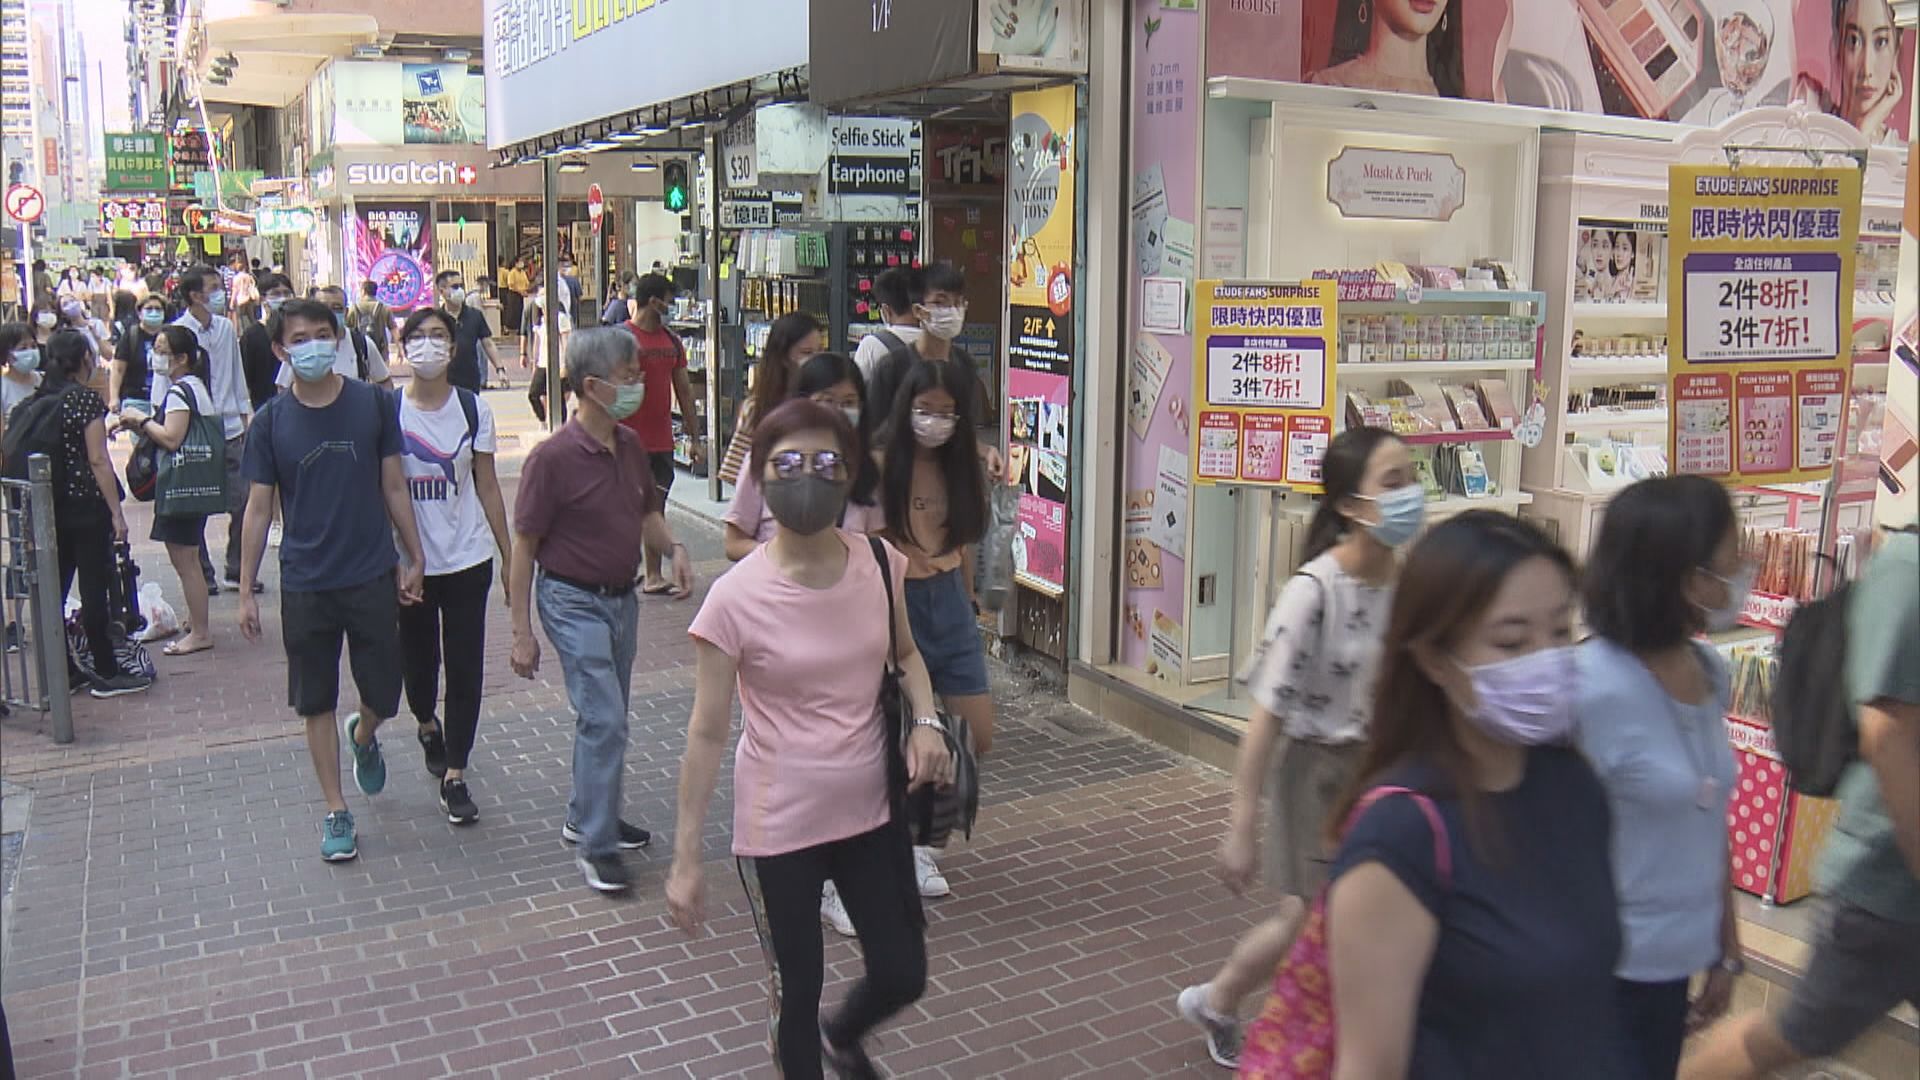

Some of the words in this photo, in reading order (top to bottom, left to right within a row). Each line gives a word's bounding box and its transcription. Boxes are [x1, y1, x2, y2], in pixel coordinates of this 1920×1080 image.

[832, 126, 869, 148] Selfie
[872, 128, 905, 148] Stick
[347, 160, 457, 184] swatch
[731, 155, 750, 183] $30
[831, 163, 905, 188] Earphone
[1363, 163, 1392, 181] Mask
[1407, 166, 1433, 183] Pack
[1013, 185, 1059, 203] NAUGHTY
[1696, 176, 1736, 195] ETUDE
[1738, 177, 1770, 196] FANS
[1772, 178, 1839, 196] SURPRISE
[368, 210, 386, 220] BIG
[388, 210, 418, 220] BOLD
[1023, 204, 1049, 219] TOYS
[1691, 207, 1841, 241] 限時快閃優惠
[1734, 256, 1793, 271] 全店任何產品
[1214, 286, 1243, 299] ETUDE
[1244, 286, 1268, 299] FANS
[1269, 286, 1320, 299] SURPRISE
[1719, 278, 1809, 312] 2件8折!
[1023, 317, 1043, 336] 2/F
[1211, 306, 1323, 328] 限時快閃優惠
[1719, 316, 1810, 349] 3件7折!
[1232, 352, 1301, 374] 2件8折!
[1232, 379, 1301, 399] 3件7折!
